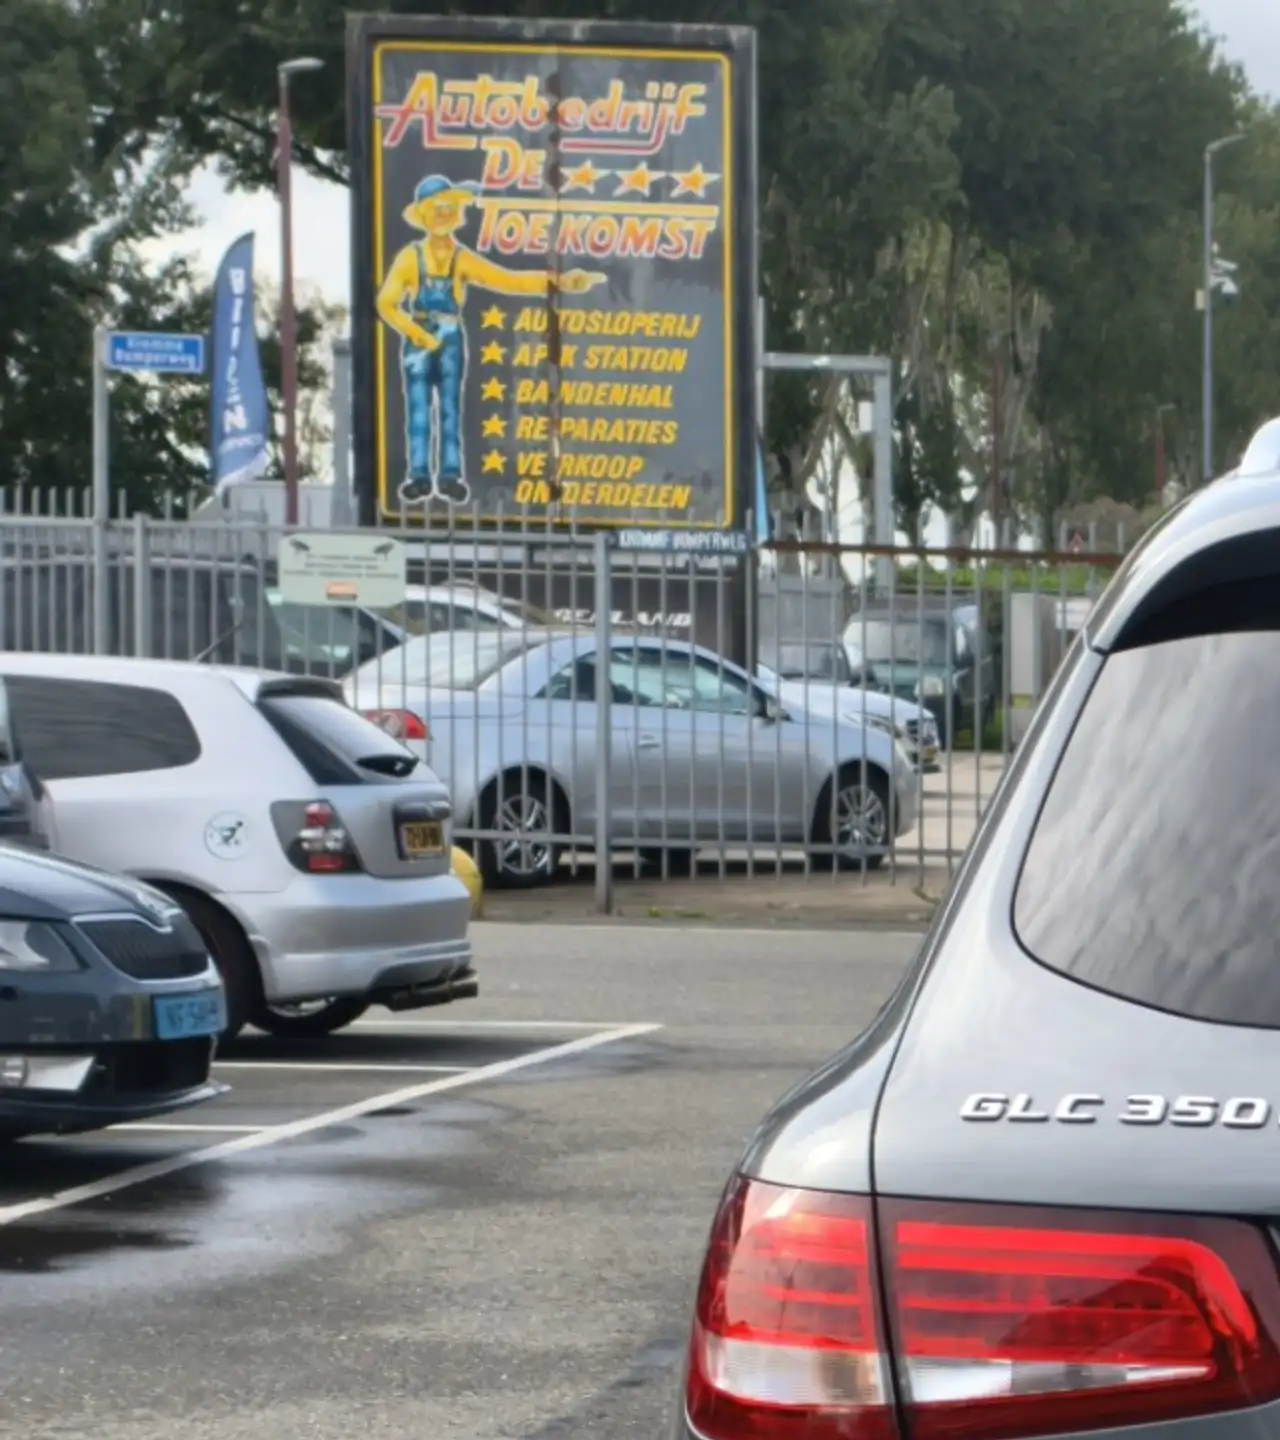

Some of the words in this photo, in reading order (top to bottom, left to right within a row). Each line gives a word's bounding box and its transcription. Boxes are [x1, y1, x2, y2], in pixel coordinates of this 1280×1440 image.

[376, 71, 706, 155] Autobedrijf
[475, 196, 720, 259] TOEKOMST
[513, 307, 702, 339] AUTOSLOPERIJ
[583, 345, 689, 374] STATION
[516, 378, 675, 409] BANDENHAL
[516, 415, 679, 446] REPARATIES
[517, 451, 646, 480] VERKOOP
[514, 479, 692, 511] ONDERDELEN
[958, 1092, 1105, 1124] GLC
